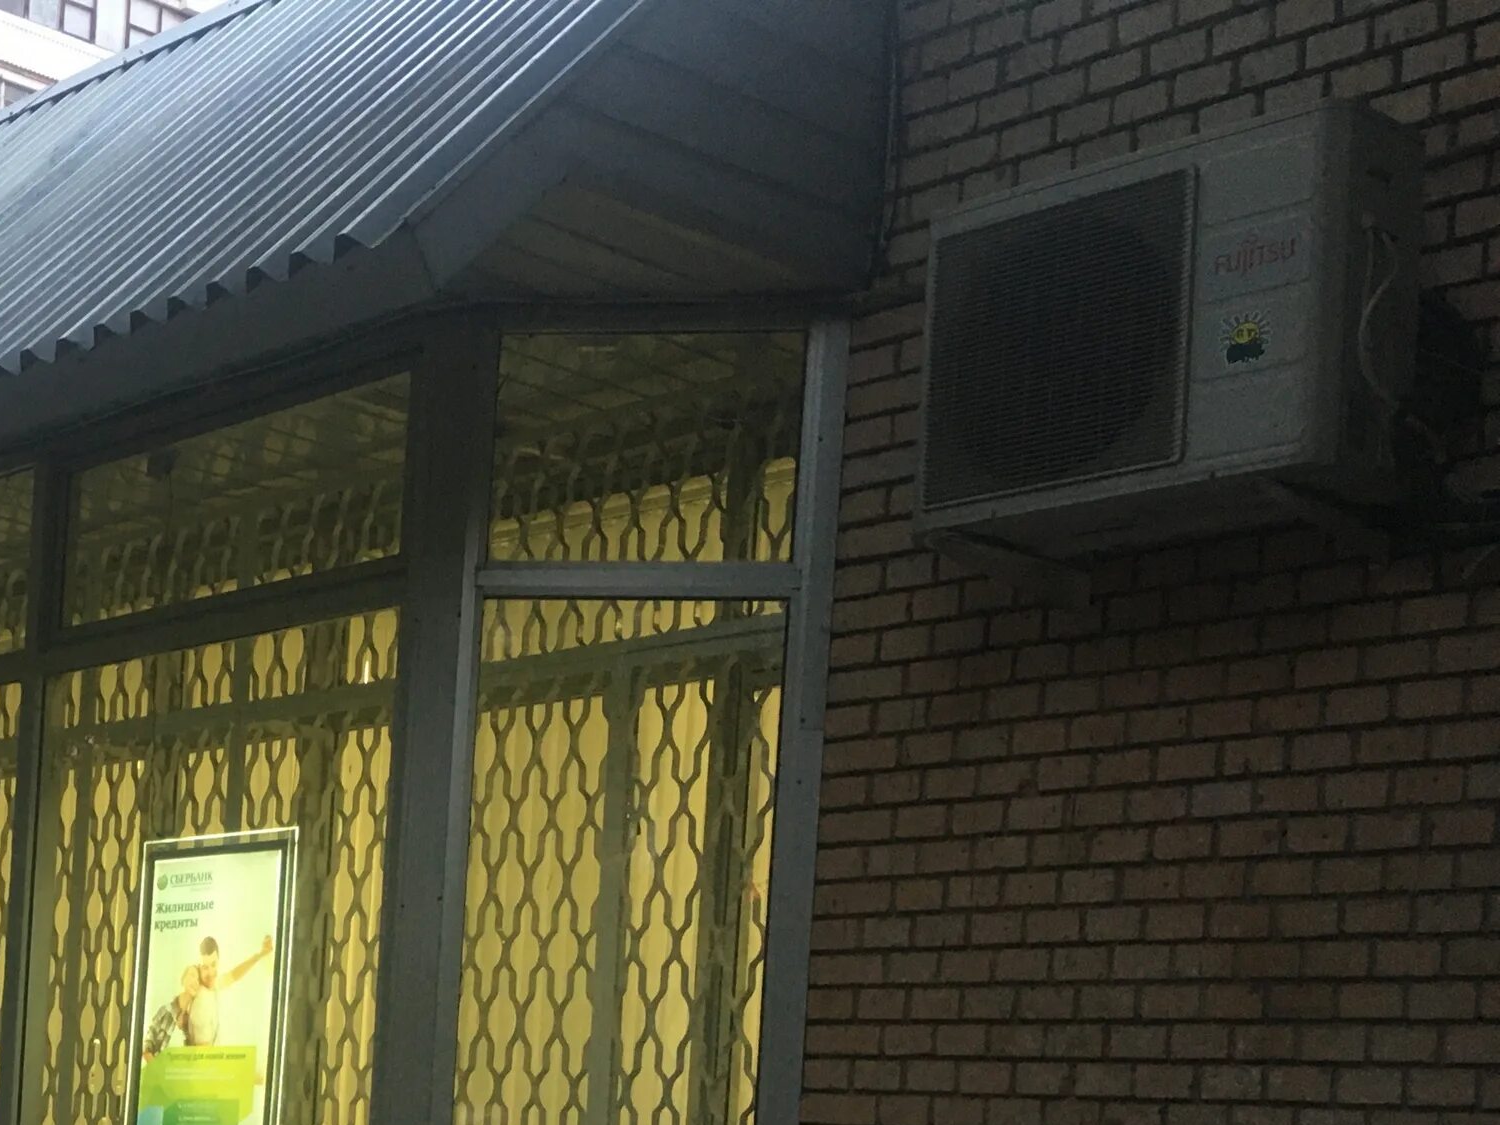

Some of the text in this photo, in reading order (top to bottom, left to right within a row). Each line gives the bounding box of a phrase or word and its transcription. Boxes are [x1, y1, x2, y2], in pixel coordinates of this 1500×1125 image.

[1213, 235, 1296, 275] FUJITSU
[170, 871, 213, 885] СБЕРБАНК
[155, 900, 214, 915] Жилищные
[154, 918, 199, 933] кредиты
